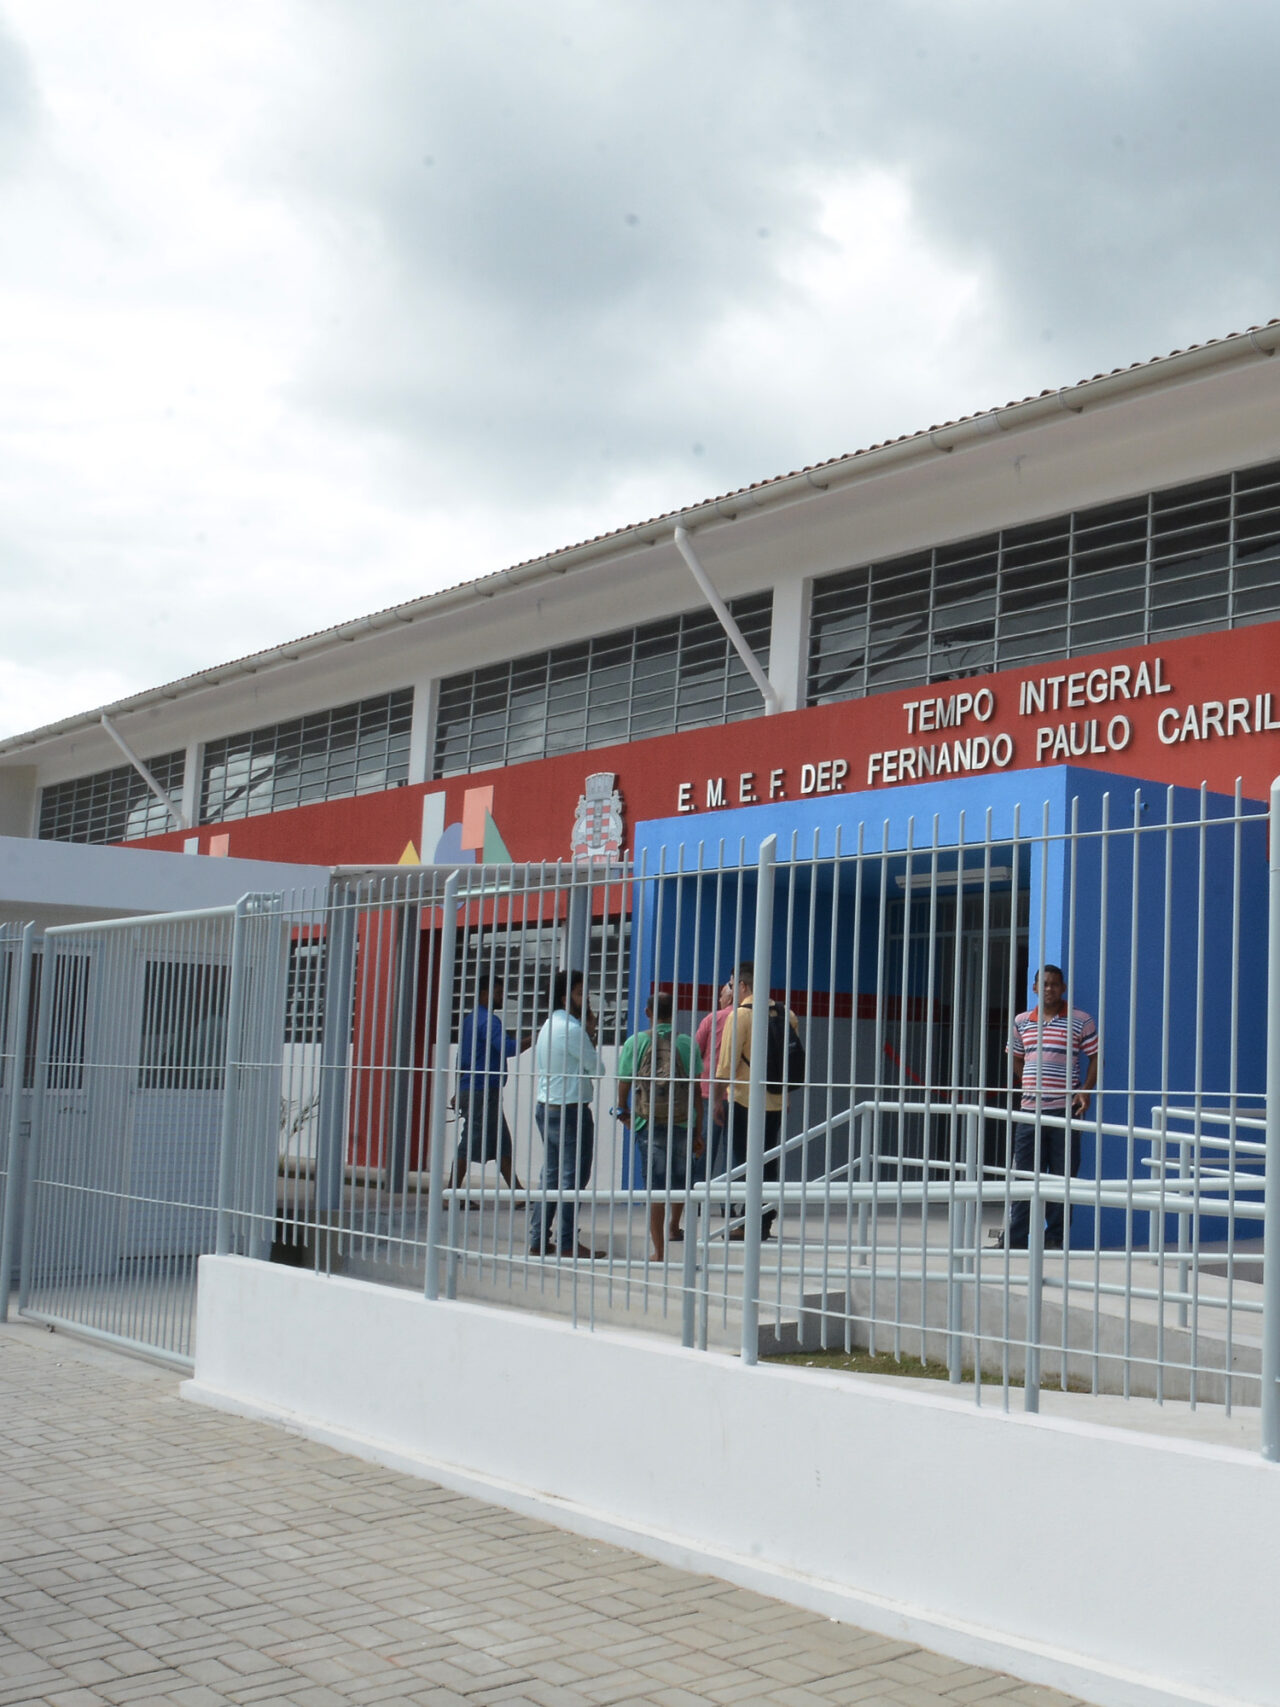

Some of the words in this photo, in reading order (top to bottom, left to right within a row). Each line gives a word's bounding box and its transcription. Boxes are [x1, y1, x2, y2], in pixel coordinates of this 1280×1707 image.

[903, 688, 994, 734] TEMPO
[1019, 658, 1171, 715] INTEGRAL
[678, 783, 695, 812] E.
[706, 778, 727, 808] M.
[739, 772, 757, 802] E.
[769, 769, 785, 797] F.
[801, 759, 848, 794] DEP.
[867, 733, 1013, 785] FERNANDO
[1036, 714, 1130, 762] PAULO
